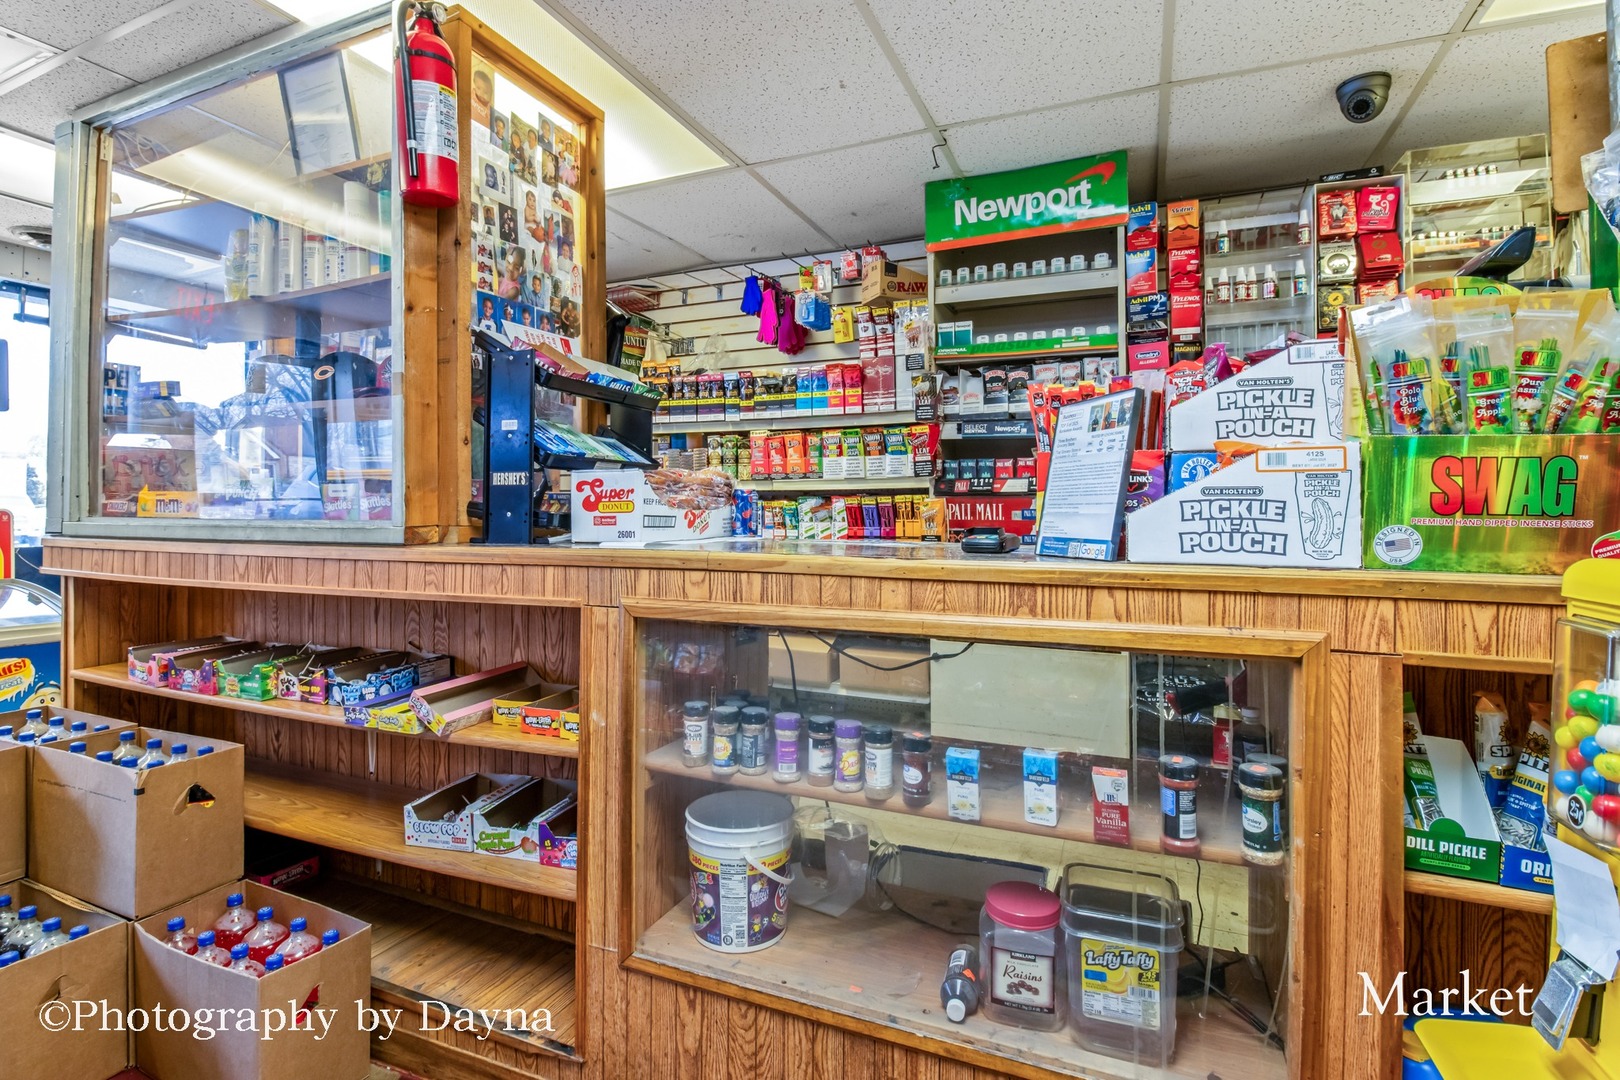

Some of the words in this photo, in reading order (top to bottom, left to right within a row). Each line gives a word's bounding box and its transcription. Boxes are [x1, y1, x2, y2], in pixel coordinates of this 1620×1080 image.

[954, 179, 1092, 226] Newport
[1129, 204, 1151, 213] Advil
[1129, 251, 1150, 259] Advil
[1171, 248, 1196, 256] TYLENOL
[896, 281, 927, 293] RAW
[1130, 296, 1148, 304] Advil
[1173, 295, 1200, 303] TYLENOL
[1136, 351, 1159, 359] Benadryl
[1520, 350, 1556, 366] SWAG
[1393, 359, 1424, 378] SWAG
[1254, 378, 1291, 386] HOLTEN'S
[1473, 370, 1504, 387] SWAG
[1521, 377, 1545, 386] Pure
[1400, 387, 1421, 397] Polo
[1511, 385, 1550, 394] Jasmine
[1217, 388, 1314, 411] PICKLE
[1400, 396, 1422, 407] Blue
[1476, 396, 1504, 407] Green
[1400, 405, 1422, 415] Type
[1476, 406, 1505, 418] Apple
[994, 424, 1022, 433] Newport
[1215, 418, 1315, 439] POUCH
[1181, 460, 1192, 475] VAN
[492, 472, 529, 486] HERSHEY'S
[1304, 479, 1340, 487] PICKLE
[1218, 487, 1261, 495] HOLTEN'S
[1430, 455, 1578, 517] SWAG
[576, 478, 635, 512] Super
[1304, 490, 1340, 498] POUCH
[324, 500, 352, 512] Skittles
[360, 495, 391, 510] Skittles
[602, 502, 631, 511] DONUT
[643, 498, 654, 506] KEEP
[947, 503, 973, 521] PALL
[975, 503, 1005, 521] MALL
[1179, 499, 1287, 523] PICKLE
[1411, 517, 1453, 526] PREMIUM
[1455, 518, 1483, 526] HAND
[1485, 519, 1518, 527] DIPPED
[1519, 519, 1560, 528] INCENSE
[1561, 520, 1594, 528] STICKS
[617, 530, 636, 539] 26001
[1375, 526, 1415, 547] DESIGNED
[1178, 532, 1288, 556] POUCH
[1080, 543, 1106, 559] Google
[0, 676, 23, 690] reat
[1101, 811, 1121, 820] PURE
[1095, 816, 1127, 828] Vanilla
[413, 821, 440, 834] BLOW
[440, 822, 461, 837] POP
[478, 829, 511, 841] Caramel
[1406, 835, 1436, 852] DILL
[1439, 841, 1487, 860] PICKLE
[691, 853, 703, 866] 380
[702, 862, 720, 872] PIECES
[1011, 952, 1036, 961] KIRKLAND
[1086, 950, 1120, 971] Laffy
[1120, 951, 1154, 972] Taffy
[1002, 964, 1043, 982] Raisins
